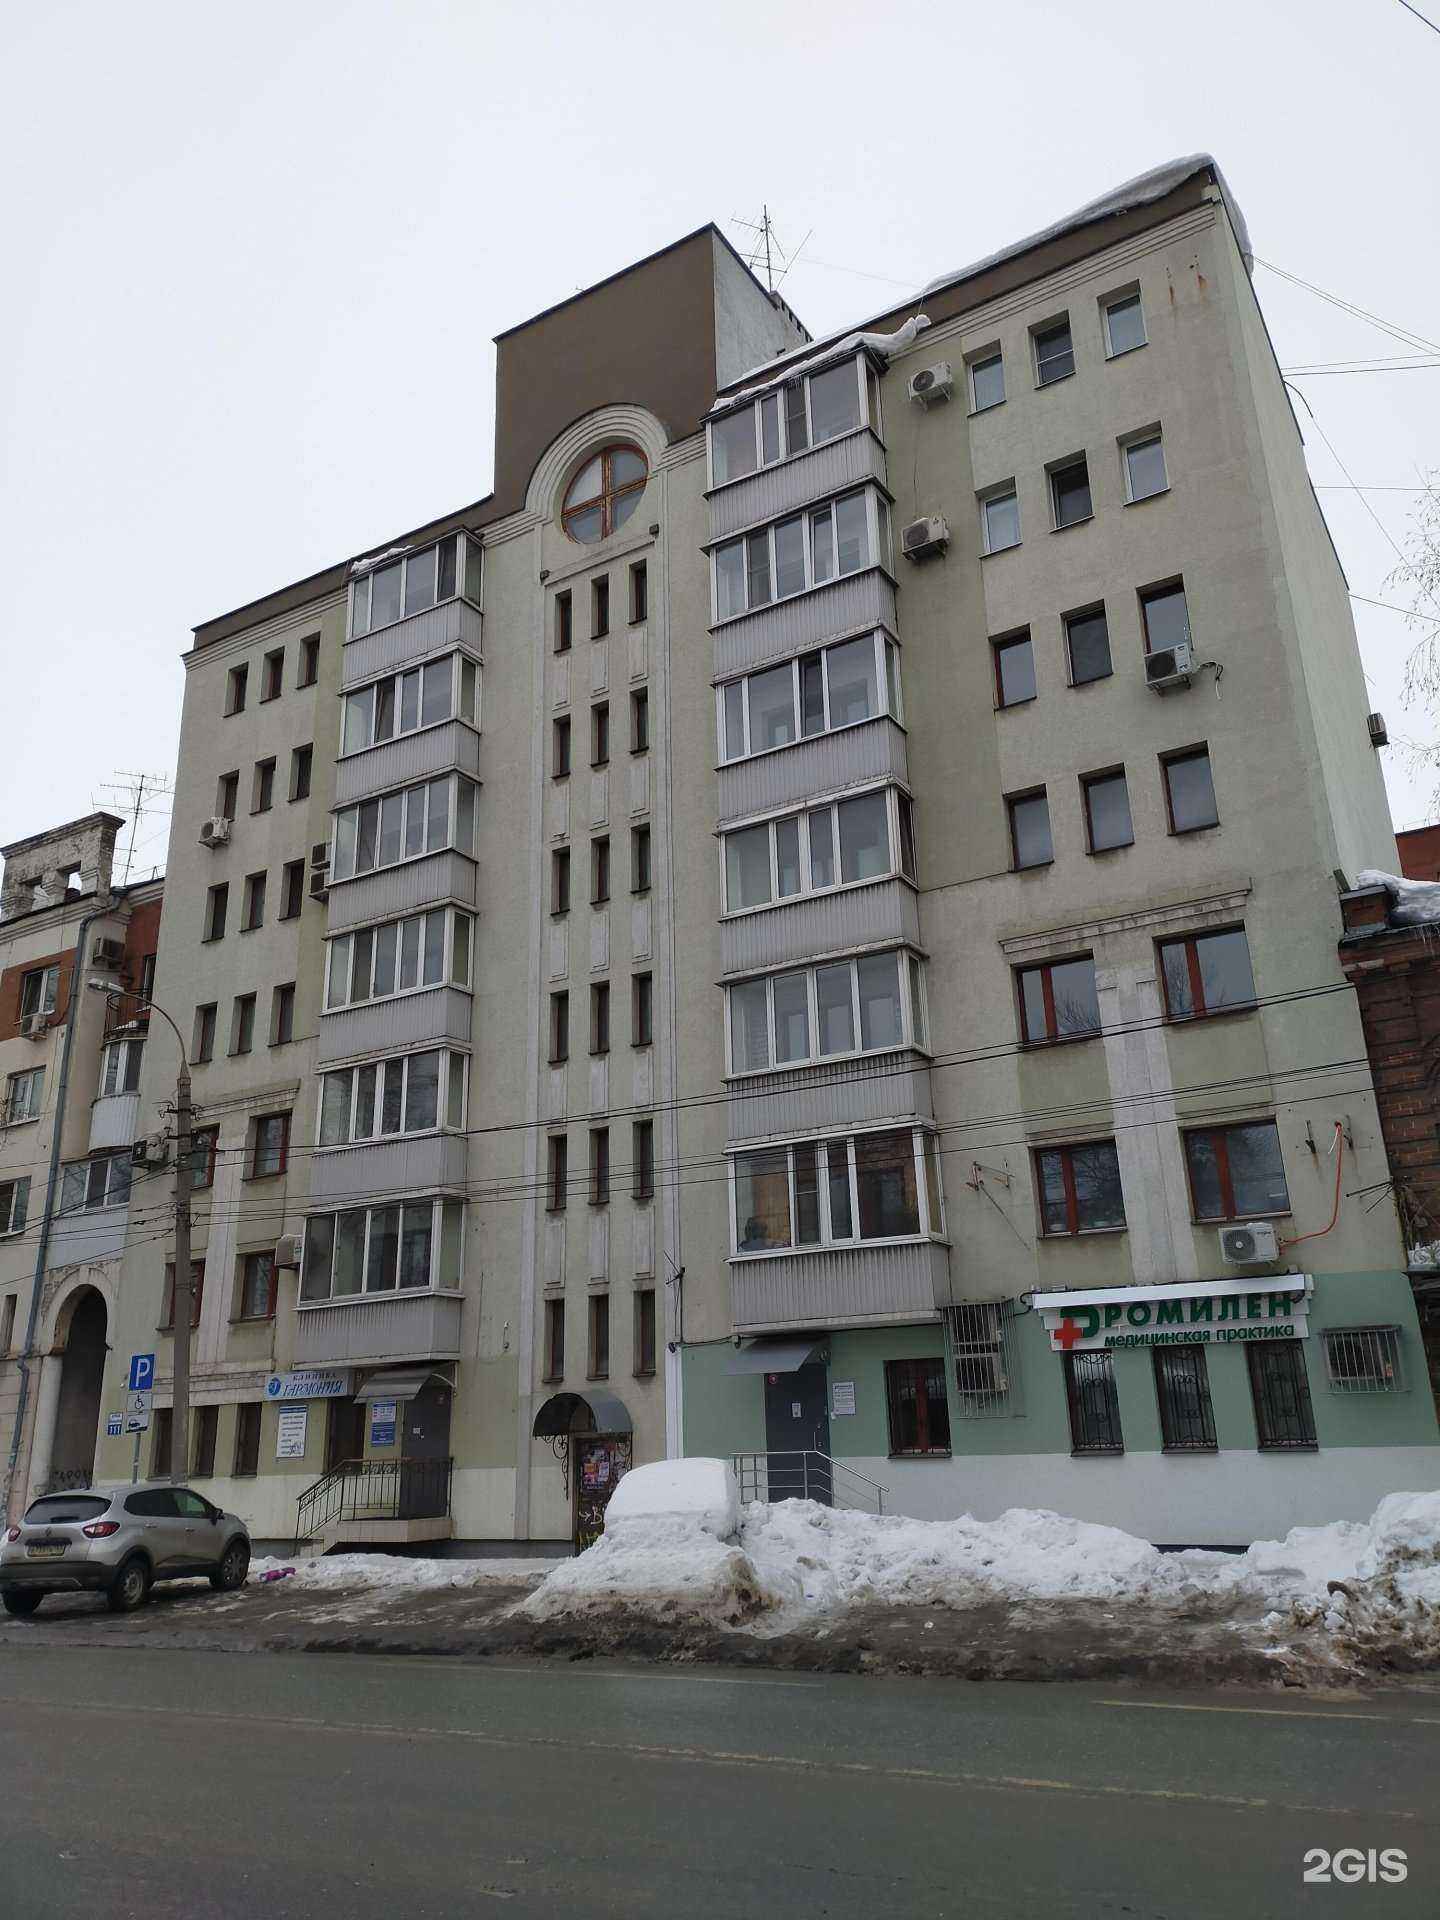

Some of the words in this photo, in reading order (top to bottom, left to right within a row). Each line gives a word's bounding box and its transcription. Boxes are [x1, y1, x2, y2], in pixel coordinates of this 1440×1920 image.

[1104, 1327, 1211, 1348] медицинская
[1216, 1323, 1295, 1343] практика
[135, 1358, 151, 1388] P
